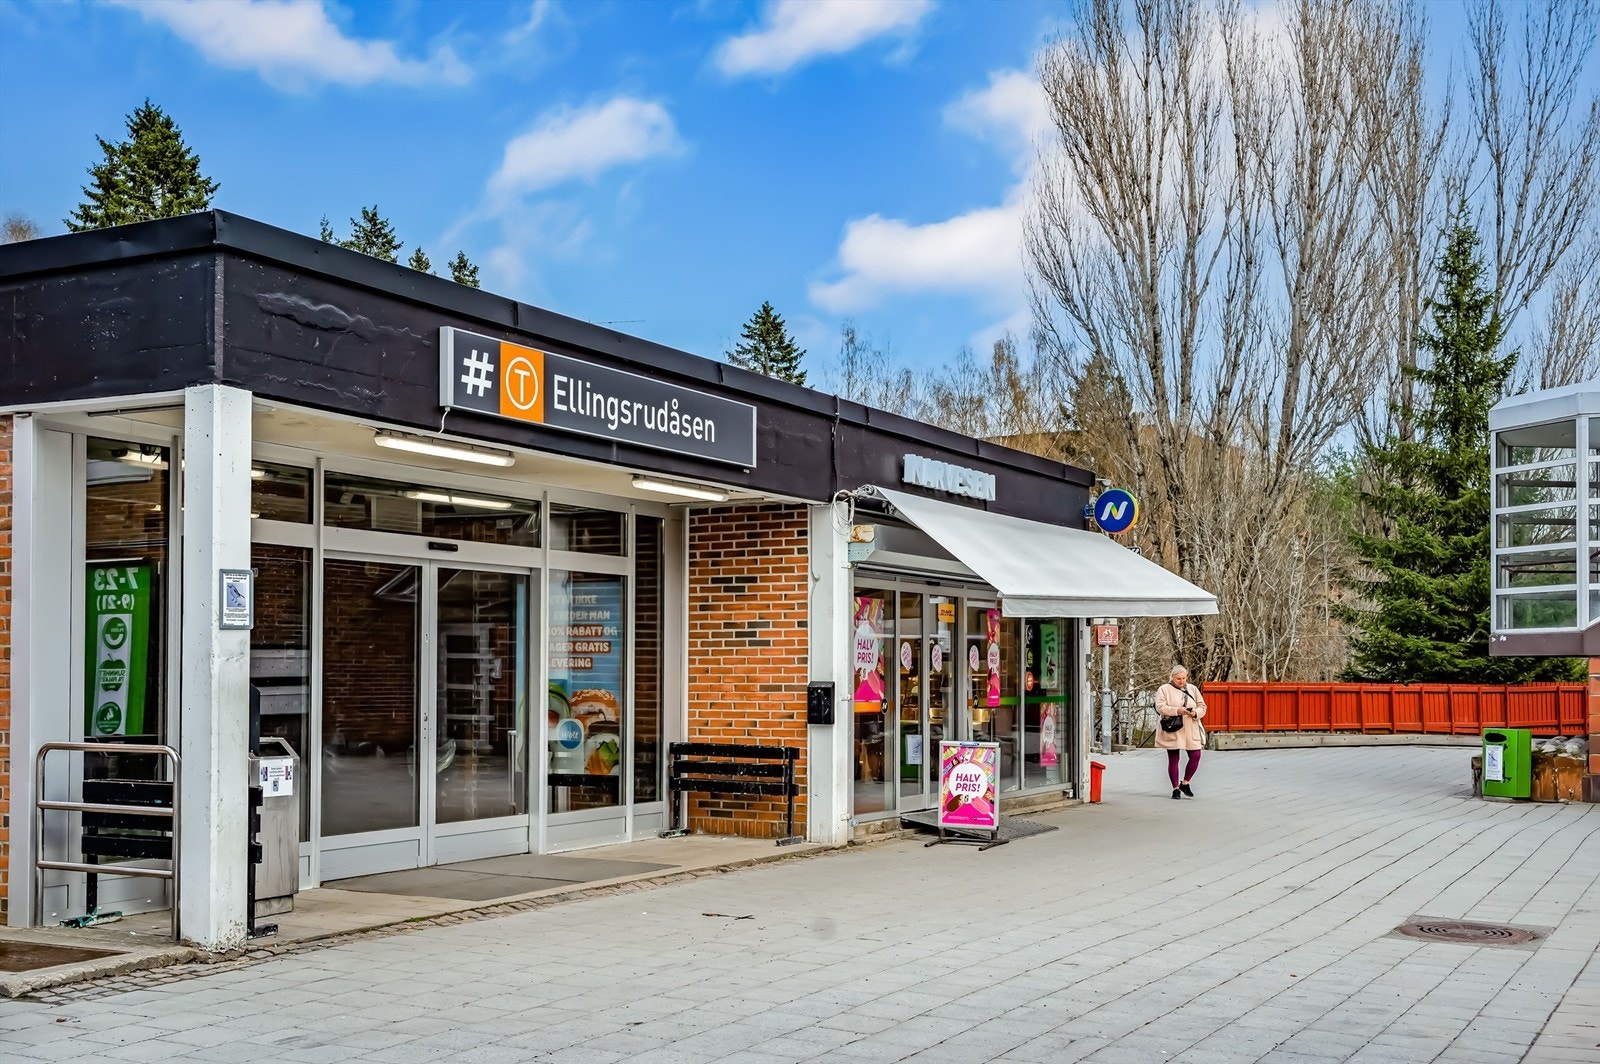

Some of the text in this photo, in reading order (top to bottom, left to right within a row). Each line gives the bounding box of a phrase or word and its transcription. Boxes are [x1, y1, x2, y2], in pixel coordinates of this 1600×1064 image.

[553, 374, 715, 443] Ellingsrudåsen
[903, 453, 996, 501] NARVESEN
[566, 626, 603, 636] RABATT
[603, 626, 618, 636] OG
[575, 642, 610, 652] GRATIS
[857, 639, 874, 650] HALV
[857, 652, 874, 664] PRIS!
[955, 773, 981, 783] HALV
[955, 783, 981, 793] PRIS!
